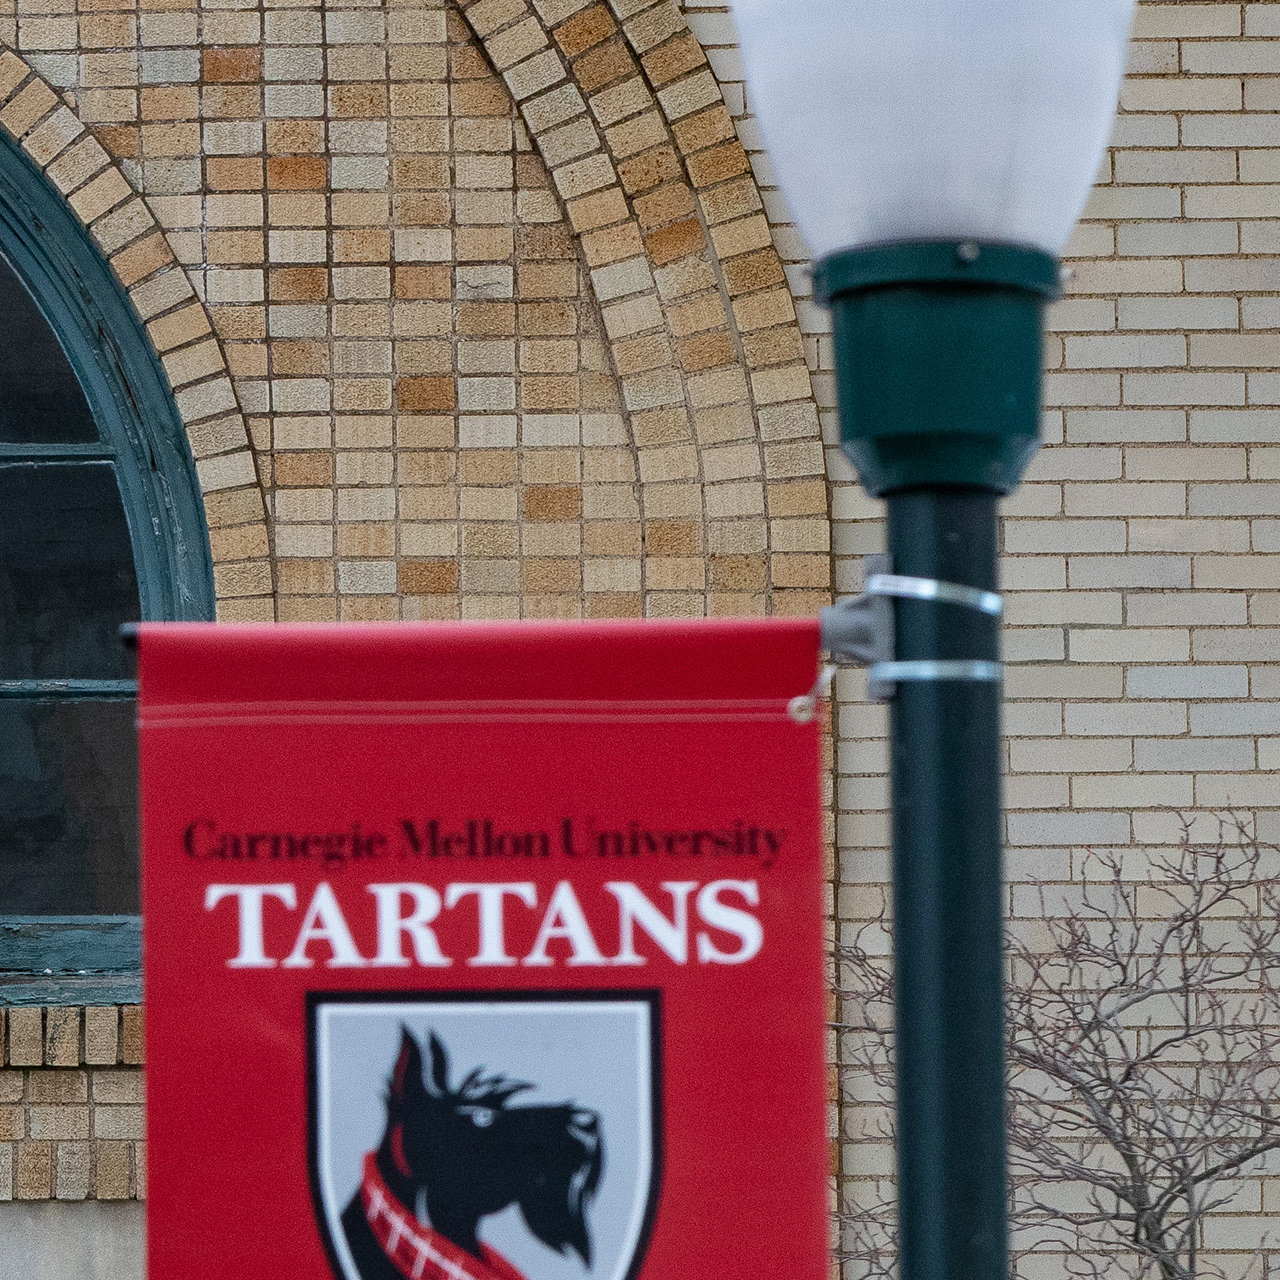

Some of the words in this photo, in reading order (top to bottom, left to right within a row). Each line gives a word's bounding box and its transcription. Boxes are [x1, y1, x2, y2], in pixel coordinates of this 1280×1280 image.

[181, 816, 387, 870] Carnegie
[398, 818, 550, 860] Mellon
[560, 817, 790, 868] University
[204, 878, 764, 969] TARTANS
